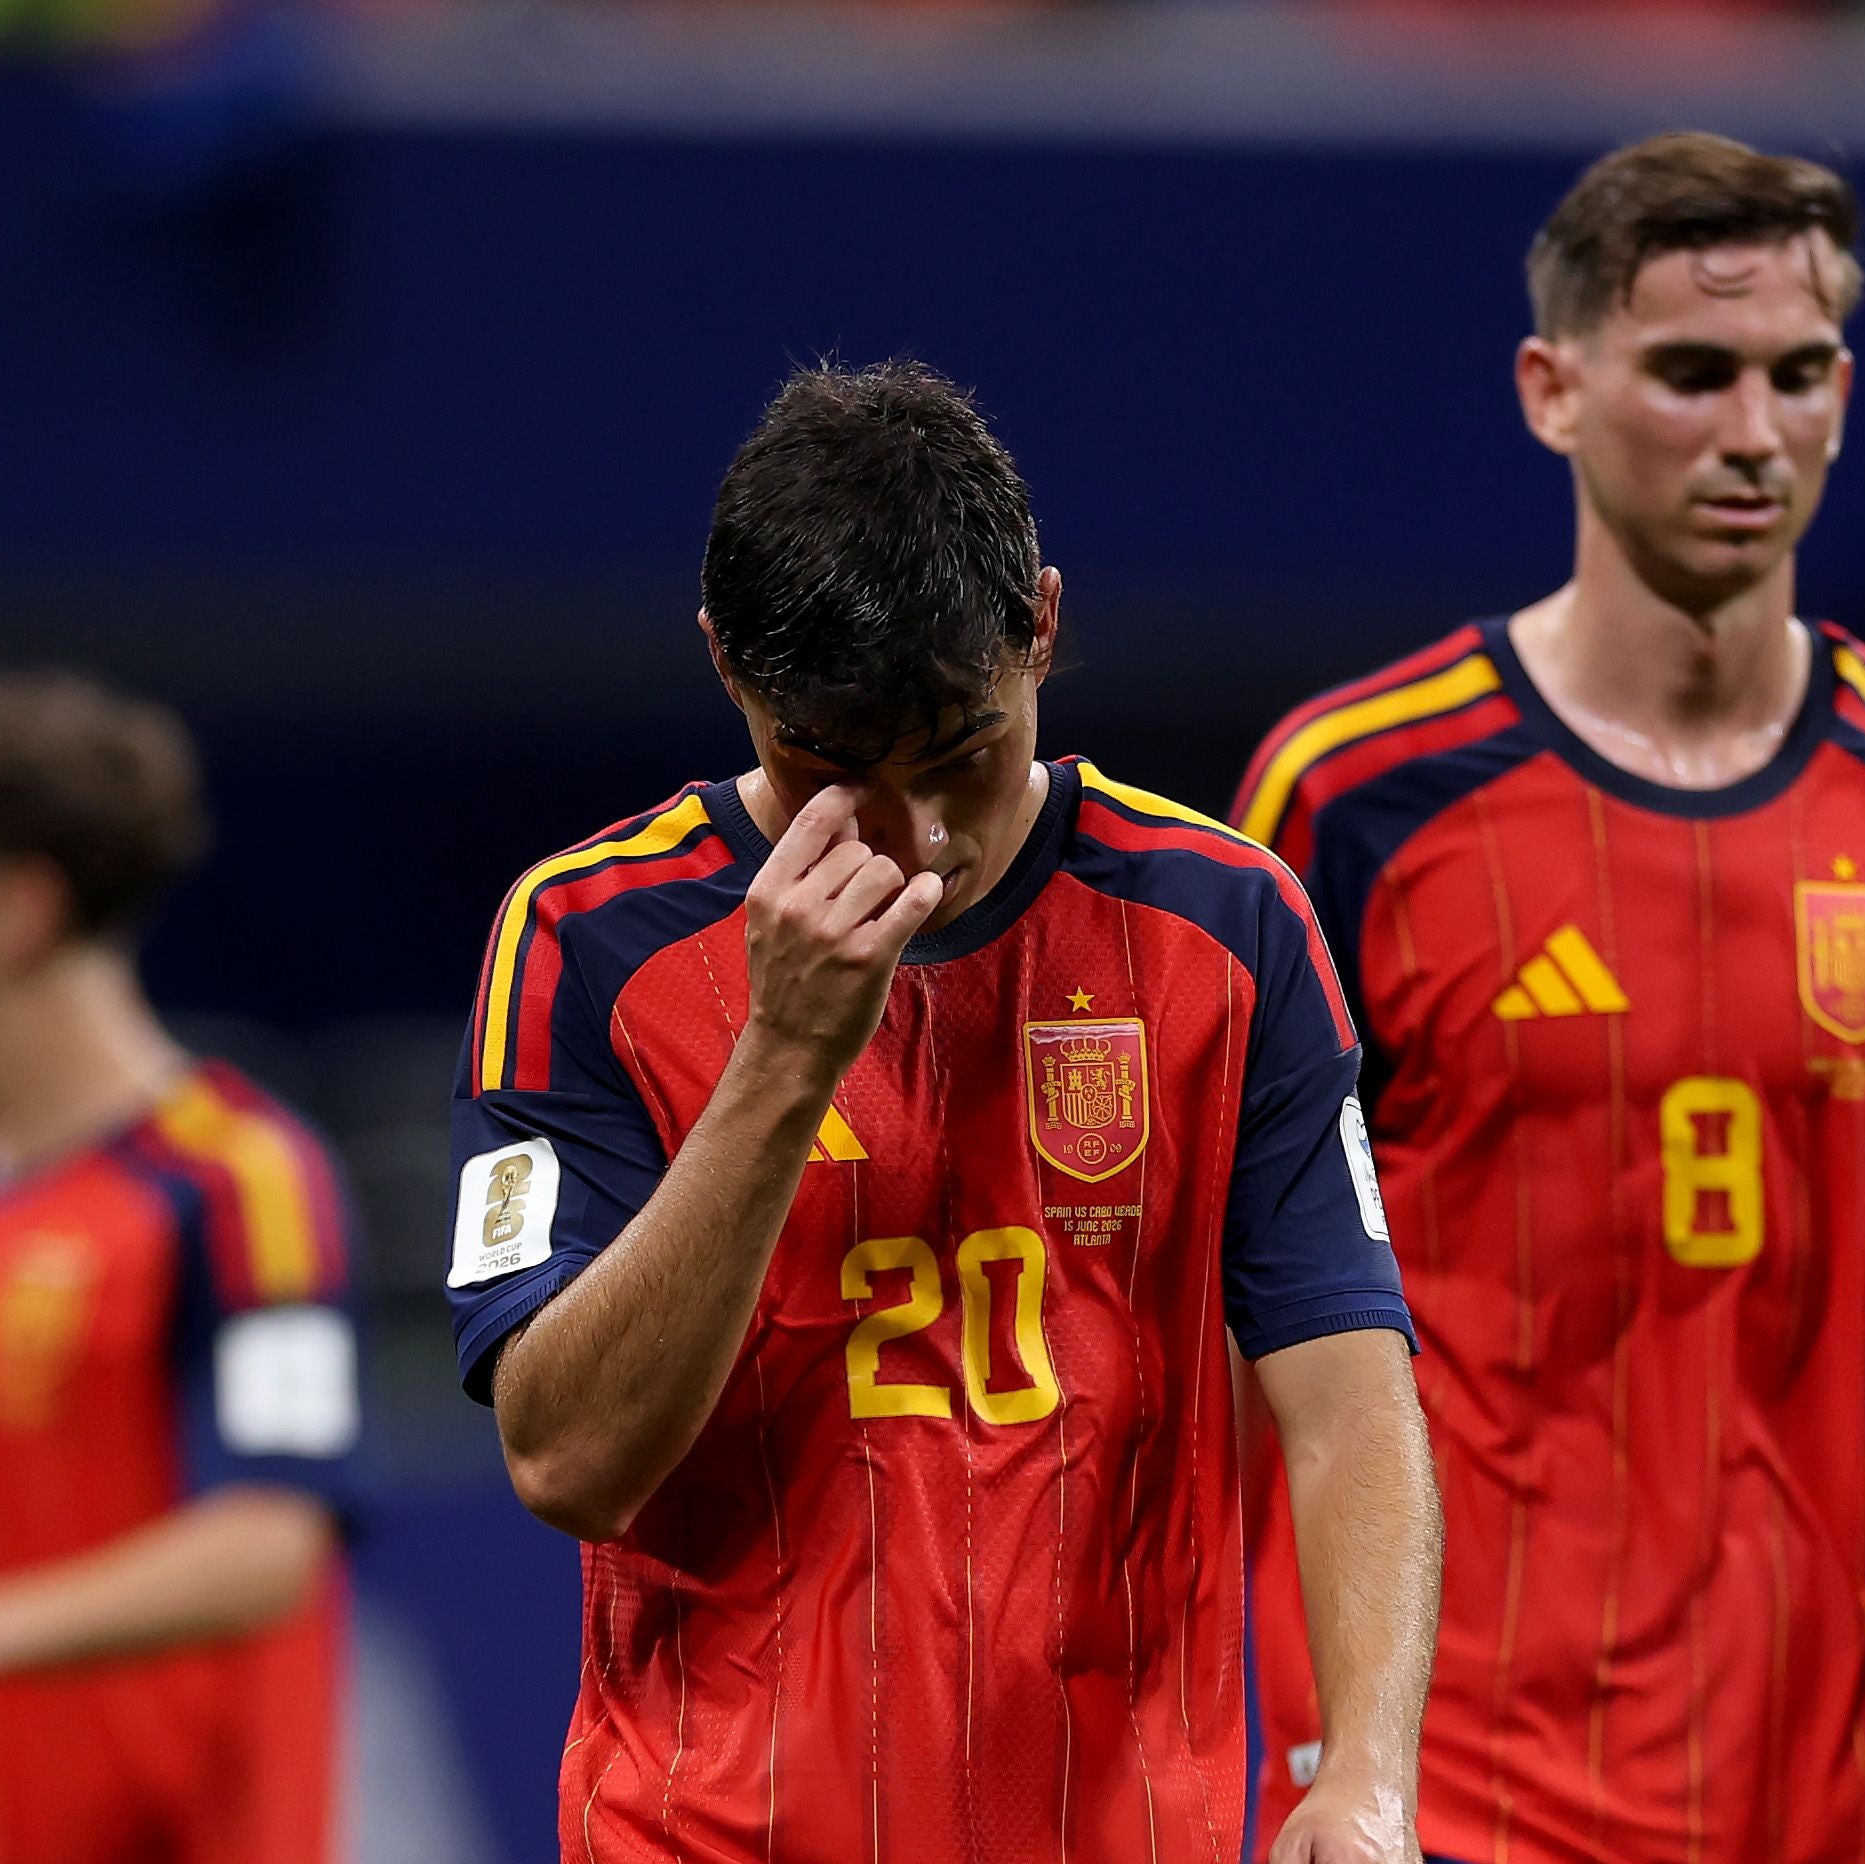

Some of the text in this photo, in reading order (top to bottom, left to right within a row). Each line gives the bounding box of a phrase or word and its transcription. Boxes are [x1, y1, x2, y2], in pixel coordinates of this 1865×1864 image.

[1660, 1075, 1764, 1267] 8
[1044, 1206, 1072, 1218] SPAIN
[492, 1223, 512, 1239] FIFA
[1064, 1219, 1123, 1232] 15 JUNE 2026
[1074, 1234, 1111, 1246] ATLANTA
[479, 1242, 523, 1262] WORLD CUP
[475, 1252, 521, 1274] 2026
[840, 1225, 1060, 1426] 20
